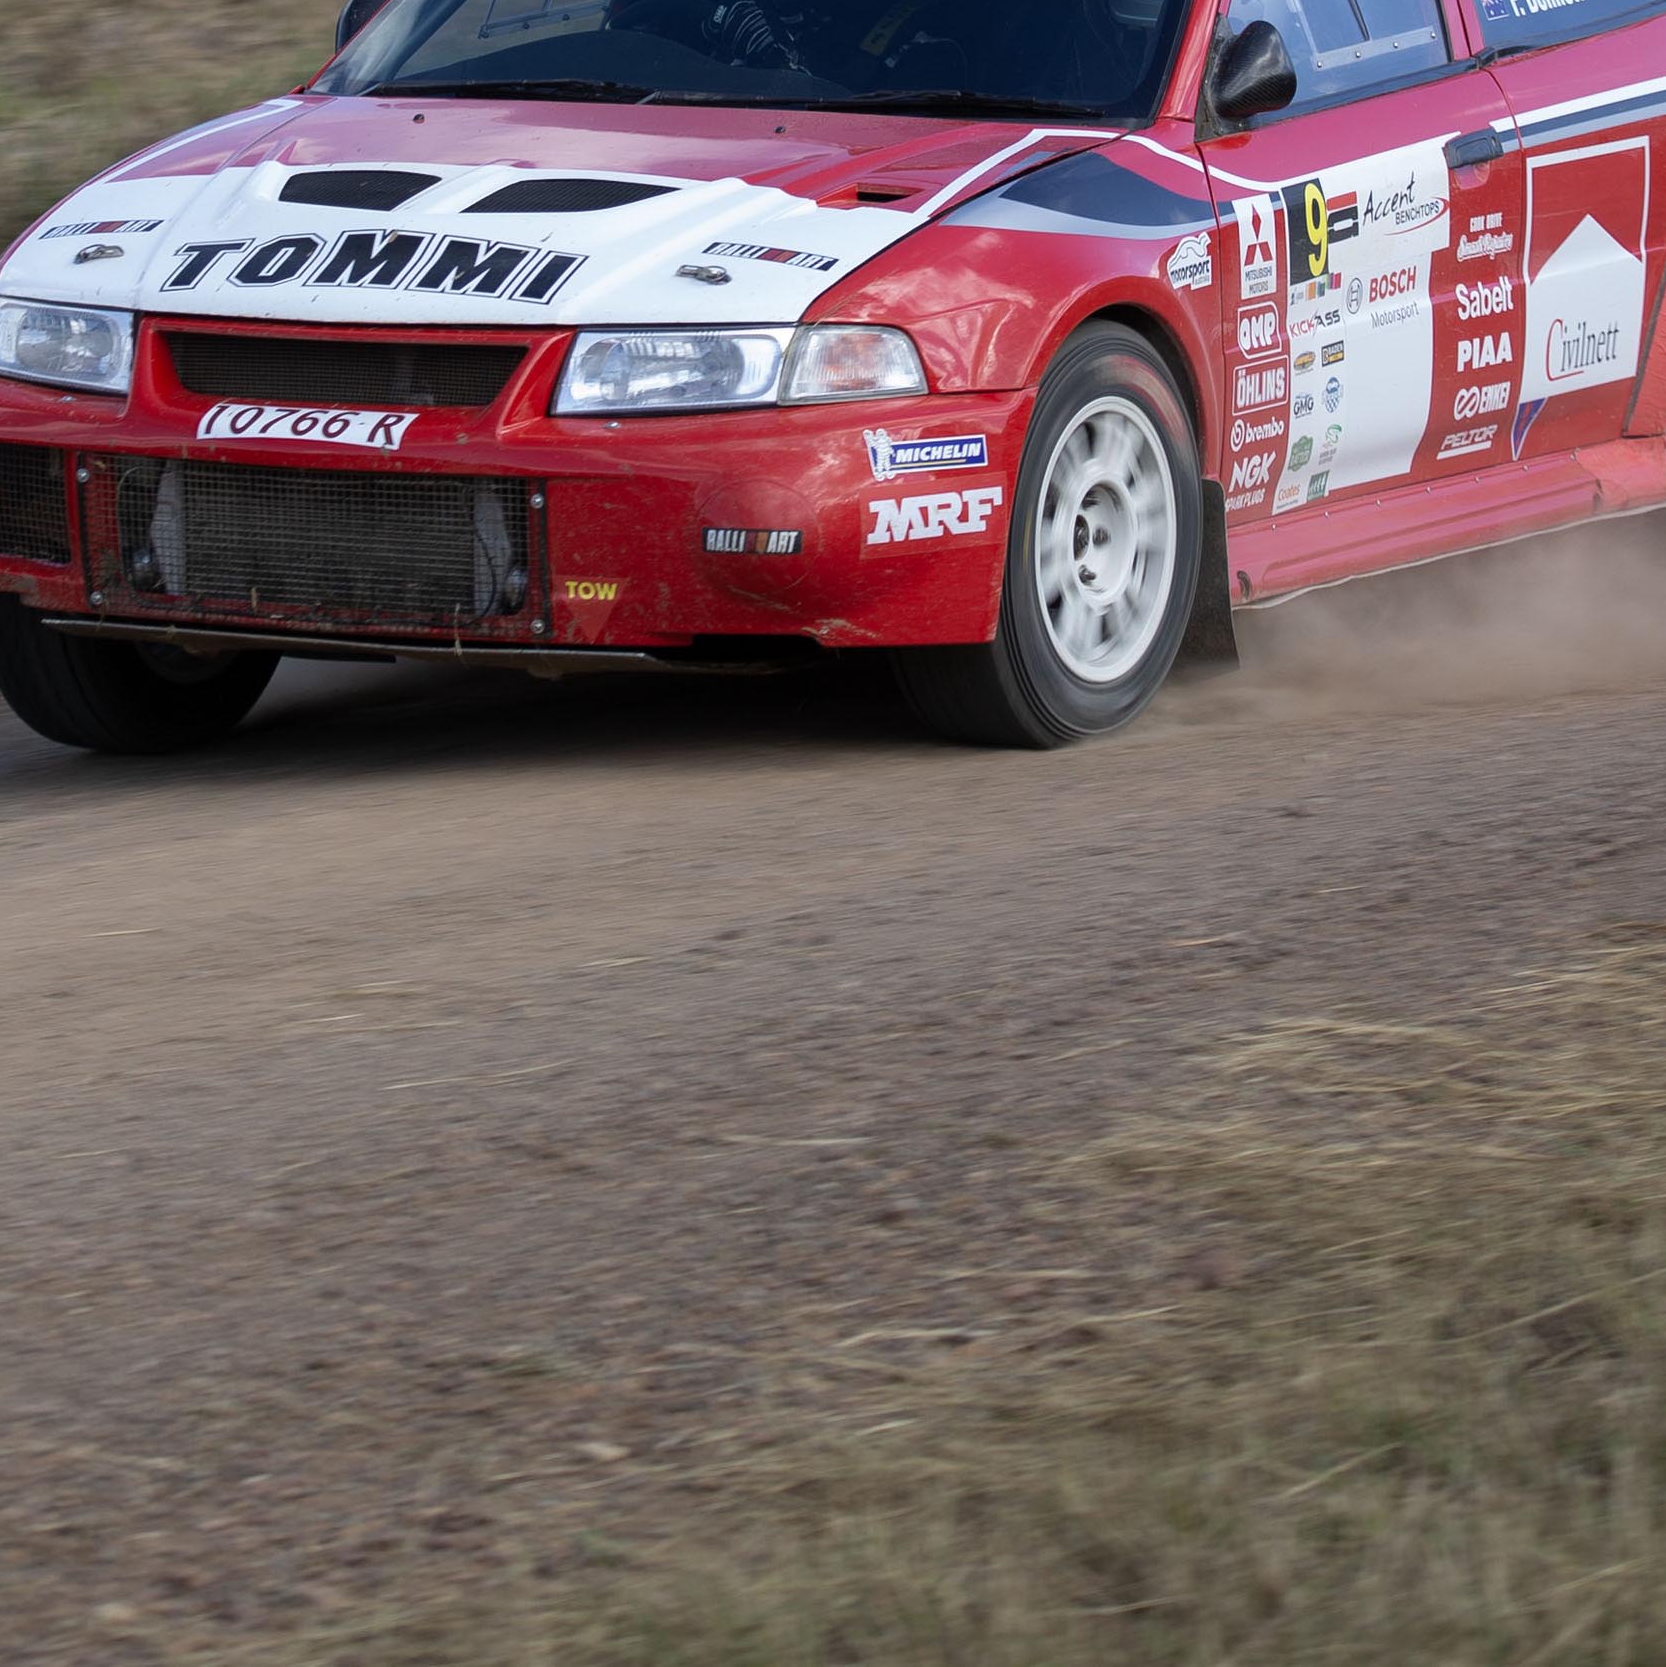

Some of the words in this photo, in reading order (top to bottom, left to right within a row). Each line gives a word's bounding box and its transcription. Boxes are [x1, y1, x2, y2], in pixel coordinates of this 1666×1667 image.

[1363, 171, 1415, 226] Accent
[1395, 200, 1440, 226] BENCHTOPS
[1304, 182, 1329, 277] 9
[159, 228, 591, 306] TOMMI
[1369, 265, 1416, 303] BOSCH
[1370, 301, 1419, 330] Motorsport
[1455, 275, 1514, 321] Sabelt
[1239, 312, 1276, 350] OMP
[1545, 318, 1620, 382] Civilnett
[1457, 331, 1513, 373] PIAA
[1236, 366, 1286, 409] ÖHLINS
[204, 405, 360, 439] 10766
[367, 413, 406, 446] R
[1245, 416, 1285, 444] brembo
[1440, 423, 1498, 450] PELTOR
[895, 442, 982, 464] MICHELIN
[1228, 450, 1276, 494] NGK
[866, 486, 1003, 546] MRF
[706, 529, 745, 552] RALLI
[766, 531, 799, 553] ART
[564, 580, 618, 601] TOW
